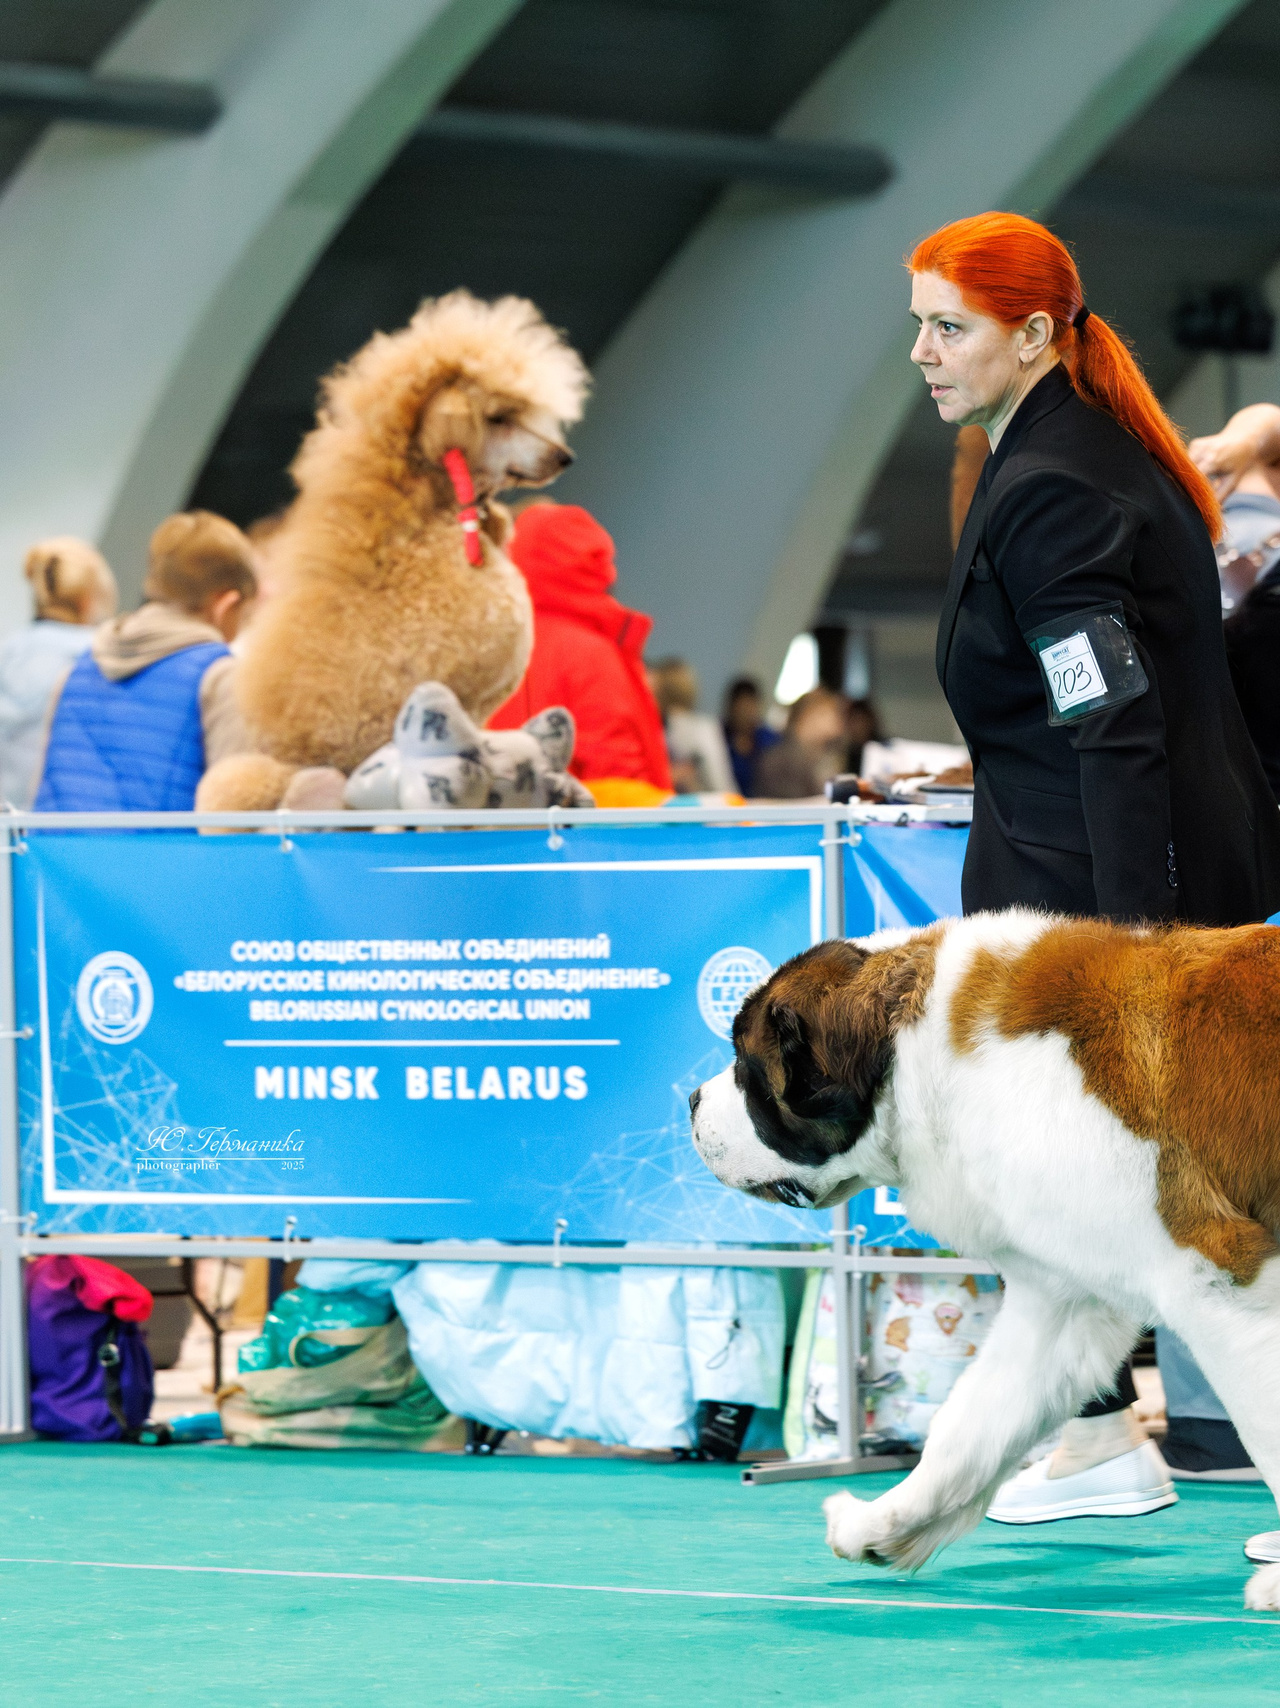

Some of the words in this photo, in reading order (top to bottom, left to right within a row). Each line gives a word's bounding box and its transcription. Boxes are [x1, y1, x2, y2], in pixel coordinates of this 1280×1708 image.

[1053, 661, 1092, 699] 203
[231, 940, 295, 962] СОЮЗ
[297, 939, 461, 964] ОБЩЕСТВЕННЫХ
[463, 933, 611, 963] ОБЪЕДИНЕНИЙ
[174, 970, 325, 992] «БЕЛОРУССКОЕ
[327, 969, 511, 992] КИНОЛОГИЧЕСКОЕ
[513, 968, 671, 992] ОБЪЕДИНЕНИЕ»
[250, 1000, 378, 1021] BELORUSSIAN
[380, 999, 523, 1021] CYNOLOGICAL
[525, 999, 591, 1020] UNION
[255, 1066, 379, 1100] MINSK
[405, 1065, 588, 1100] BELARUS
